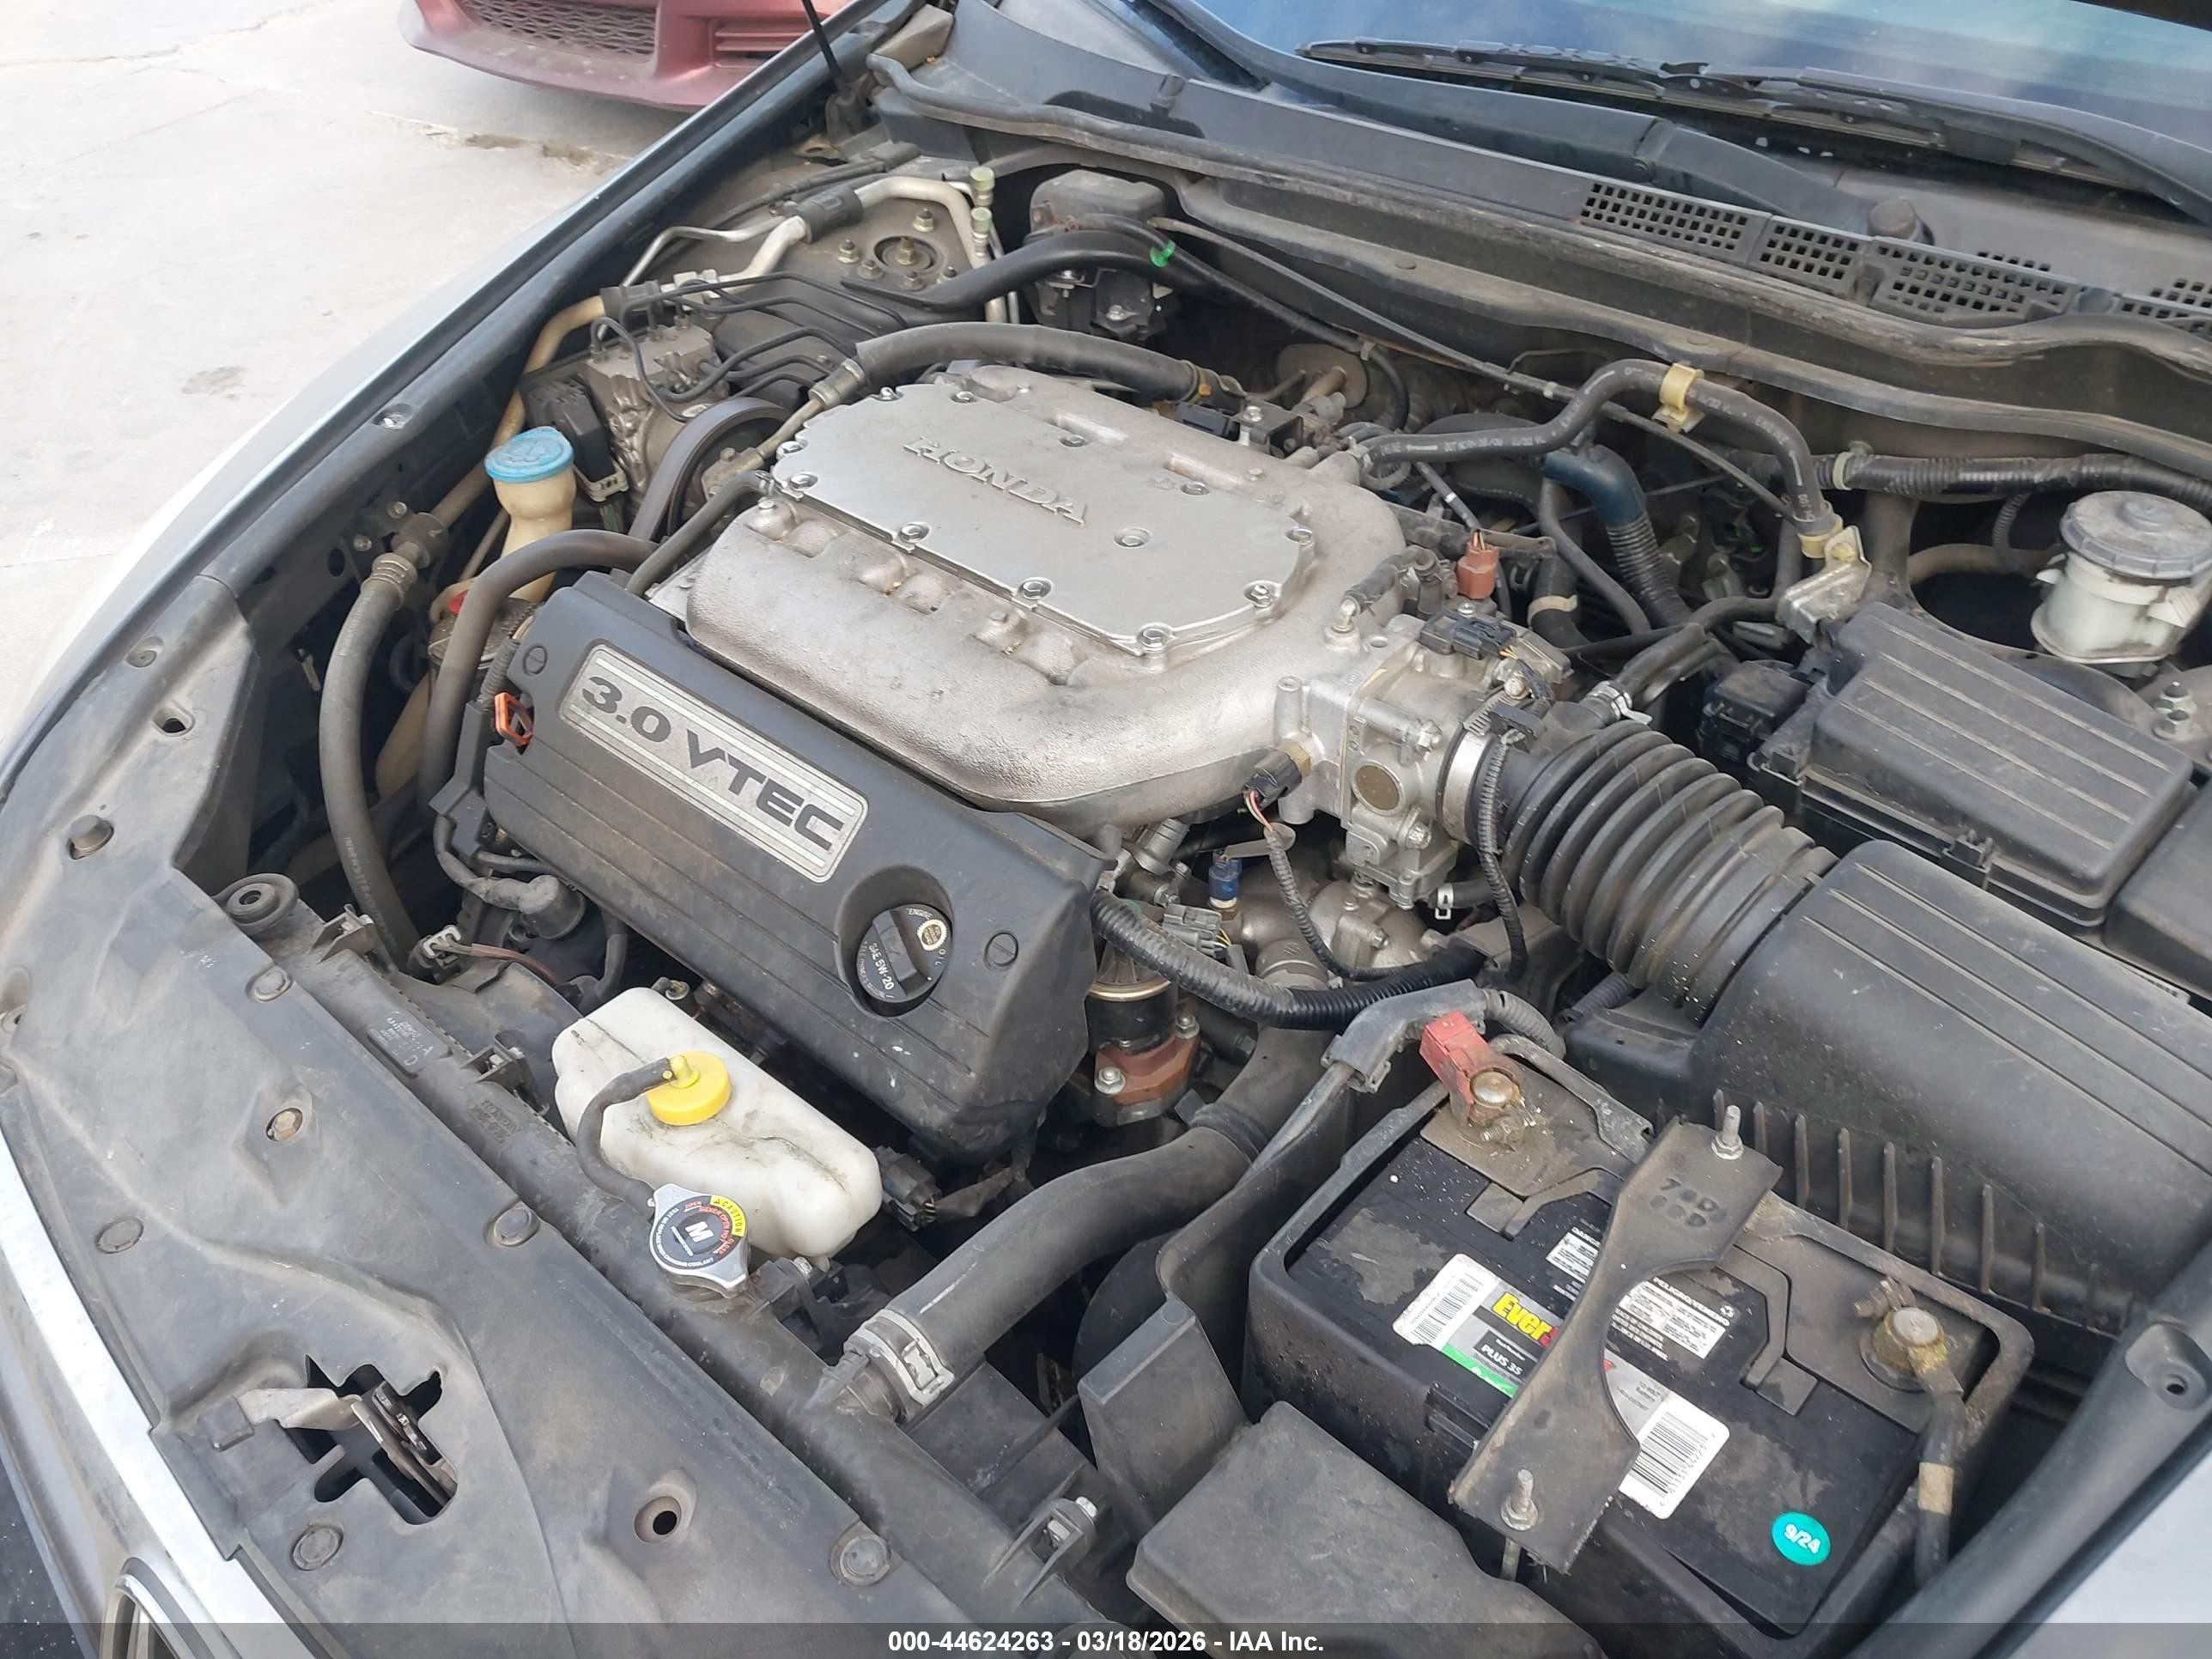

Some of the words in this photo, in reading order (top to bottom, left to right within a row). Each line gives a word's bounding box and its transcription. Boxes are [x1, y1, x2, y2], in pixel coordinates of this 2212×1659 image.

[903, 435, 1087, 526] HONDA
[582, 677, 672, 742] 3.0
[687, 728, 844, 851] VTEC
[868, 943, 882, 960] SAE
[875, 959, 895, 990] 5W-20
[685, 1221, 714, 1243] M
[722, 1201, 743, 1232] CAUTION
[1481, 1344, 1510, 1367] PLUS
[1784, 1523, 1820, 1554] 9/24
